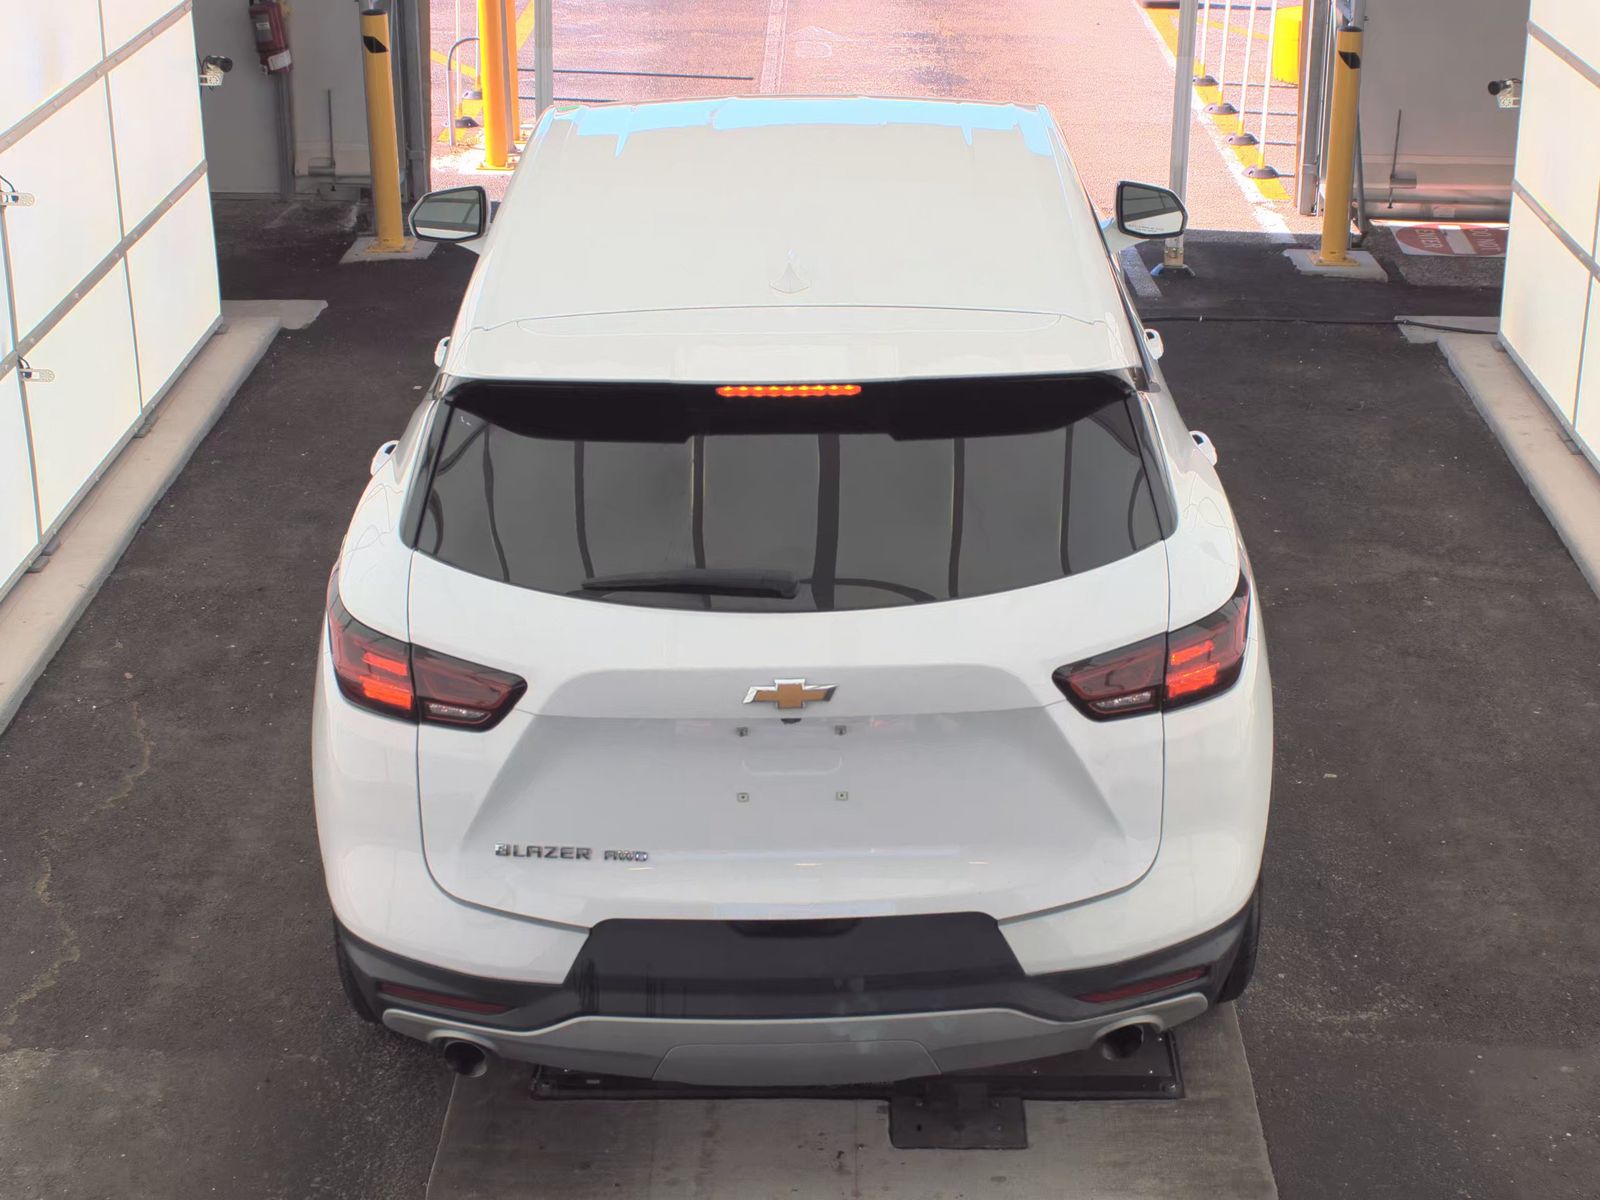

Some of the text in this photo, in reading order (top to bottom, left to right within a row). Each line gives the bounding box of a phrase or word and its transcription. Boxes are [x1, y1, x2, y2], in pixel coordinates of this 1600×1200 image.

[1415, 229, 1443, 248] ENTER
[495, 843, 649, 862] BLAZER AWD
